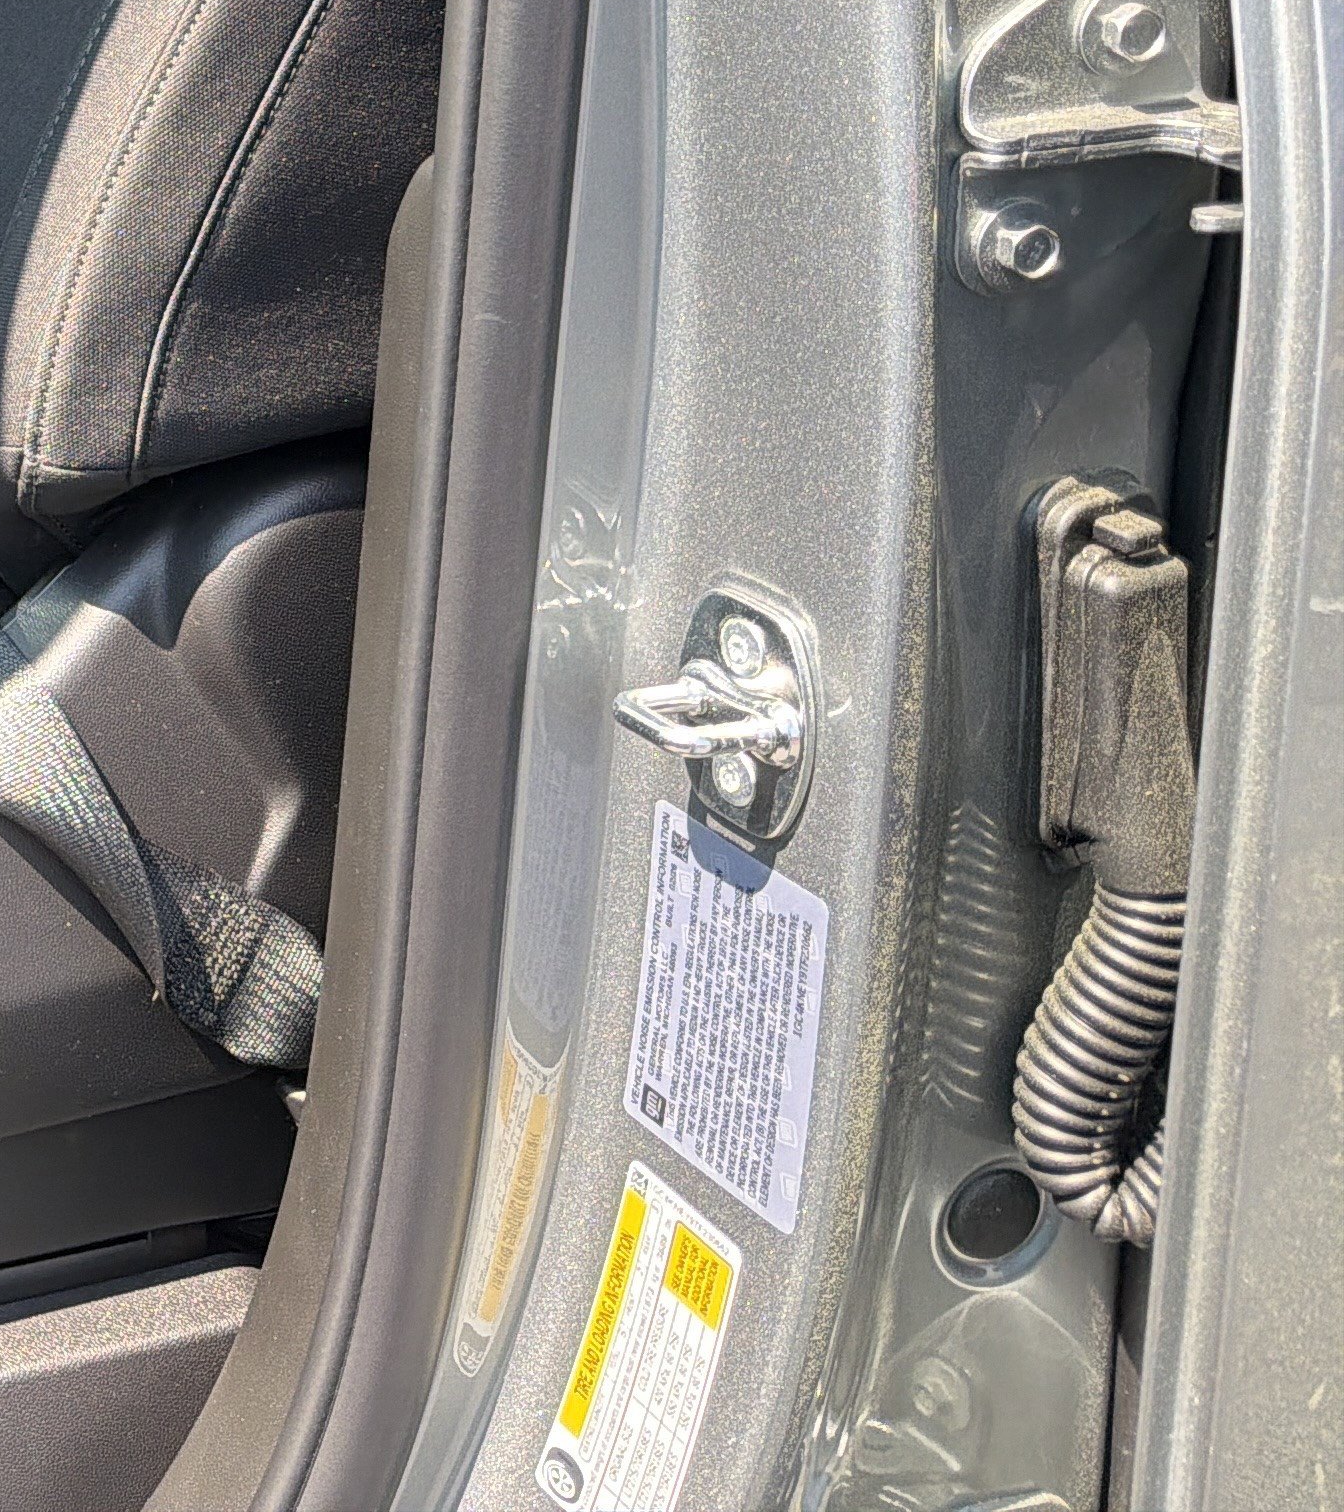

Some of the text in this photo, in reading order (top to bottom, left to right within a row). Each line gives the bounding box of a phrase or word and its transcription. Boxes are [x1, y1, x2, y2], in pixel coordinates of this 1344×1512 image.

[693, 867, 701, 894] NOISE
[665, 895, 674, 928] BUILT
[691, 894, 699, 913] FOR
[711, 903, 719, 923] ANY
[722, 903, 731, 922] THE
[709, 922, 718, 937] BY
[778, 913, 786, 928] OR
[685, 913, 697, 971] REGULATIONS
[730, 931, 739, 950] FOR
[741, 926, 751, 954] NOISE
[774, 928, 785, 961] DEVICE
[631, 812, 670, 1104] VEHICLE NOISE EMISSION CONTROL INFORMATION
[706, 935, 716, 974] THEREOF
[717, 958, 725, 972] OF
[728, 950, 736, 973] THAN
[739, 954, 747, 974] ANY
[683, 972, 691, 989] EPA
[695, 956, 703, 983] HEAVY
[715, 971, 723, 991] ACT
[737, 972, 746, 986] OF
[772, 960, 782, 986] SUCH
[662, 975, 674, 1029] MICHIGAN
[693, 984, 701, 1004] AND
[702, 976, 712, 1014] CAUSING
[725, 975, 734, 1004] OTHER
[747, 988, 756, 1006] THE
[769, 986, 779, 1015] AFTER
[781, 971, 793, 1019] RENDERED
[648, 951, 668, 1076] GENERAL MOTORS LLC
[679, 1005, 688, 1018] TO
[689, 1004, 698, 1037] MEDIUM
[700, 1014, 709, 1032] THE
[711, 992, 722, 1031] CONTROL
[746, 1006, 754, 1018] IN
[698, 1032, 707, 1046] OR
[766, 1015, 777, 1052] VEHICLE
[779, 1018, 788, 1033] OR
[674, 1018, 686, 1066] CONFORMS
[686, 1037, 695, 1050] TO
[708, 1031, 718, 1058] NOISE
[737, 911, 775, 1190] INCORPORATED INTO THIS VEHICLE IN COMPLIANCE WITH THE NOISE
[775, 1033, 787, 1076] REMOVED
[695, 1046, 705, 1070] ACTS
[705, 1058, 715, 1074] THE
[729, 1050, 738, 1065] OR
[739, 1050, 749, 1083] DESIGN
[763, 1052, 773, 1072] THIS
[669, 1065, 680, 1101] VEHICLE
[681, 1050, 693, 1102] APPLICABLE
[704, 1074, 712, 1089] BY
[713, 1062, 725, 1111] RENDERING
[737, 1083, 745, 1096] OF
[762, 1072, 770, 1086] OF
[772, 1076, 782, 1101] BEEN
[689, 1070, 702, 1119] FOLLOWING
[760, 1085, 769, 1105] USE
[666, 1101, 675, 1121] THIS
[674, 1101, 686, 1142] EMISSION
[697, 1089, 710, 1139] PROHIBITED
[710, 1111, 719, 1125] OR
[732, 1096, 743, 1136] ELEMENT
[757, 1104, 767, 1122] THE
[770, 1100, 779, 1120] HAS
[686, 1118, 696, 1136] THE
[766, 1119, 776, 1153] DESIGN
[695, 1138, 704, 1158] ARE
[705, 1126, 717, 1166] REMOVAL
[730, 1136, 739, 1150] OR
[715, 1159, 723, 1174] OF
[726, 1150, 737, 1182] DEVICE
[764, 1151, 772, 1166] OF
[748, 1159, 760, 1198] CONTROL
[759, 1165, 771, 1207] ELEMENT
[605, 1231, 634, 1304] INFORMATION
[681, 1244, 699, 1298] MANUAL FOR
[691, 1257, 709, 1304] ADDITIONAL
[671, 1273, 682, 1292] SEE
[700, 1260, 718, 1316] INFORMATION
[590, 1301, 614, 1352] LOADING
[583, 1348, 599, 1377] AND
[574, 1371, 593, 1400] TIRE
